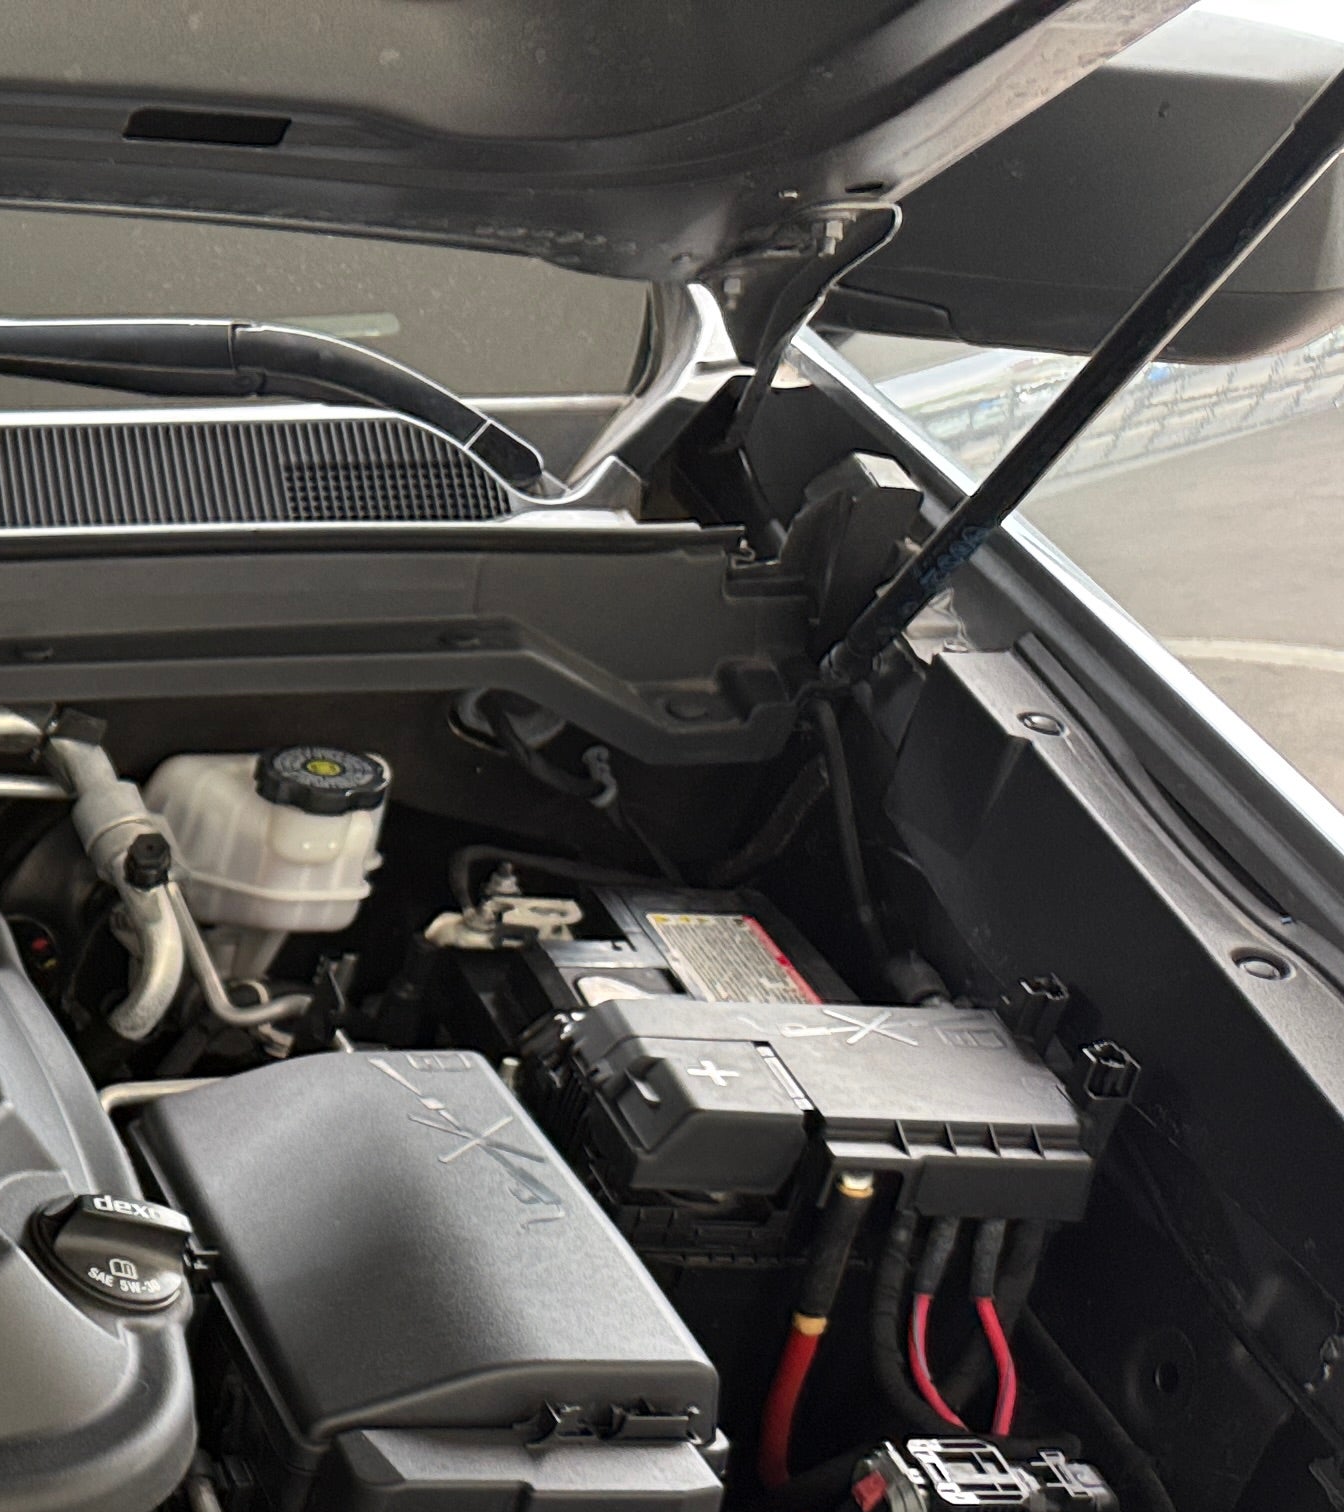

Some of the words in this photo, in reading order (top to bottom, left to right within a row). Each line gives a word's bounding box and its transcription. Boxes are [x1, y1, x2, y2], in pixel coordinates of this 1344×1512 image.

[92, 1194, 169, 1223] dexo
[87, 1267, 113, 1288] SAE
[119, 1278, 161, 1294] 5W-30
